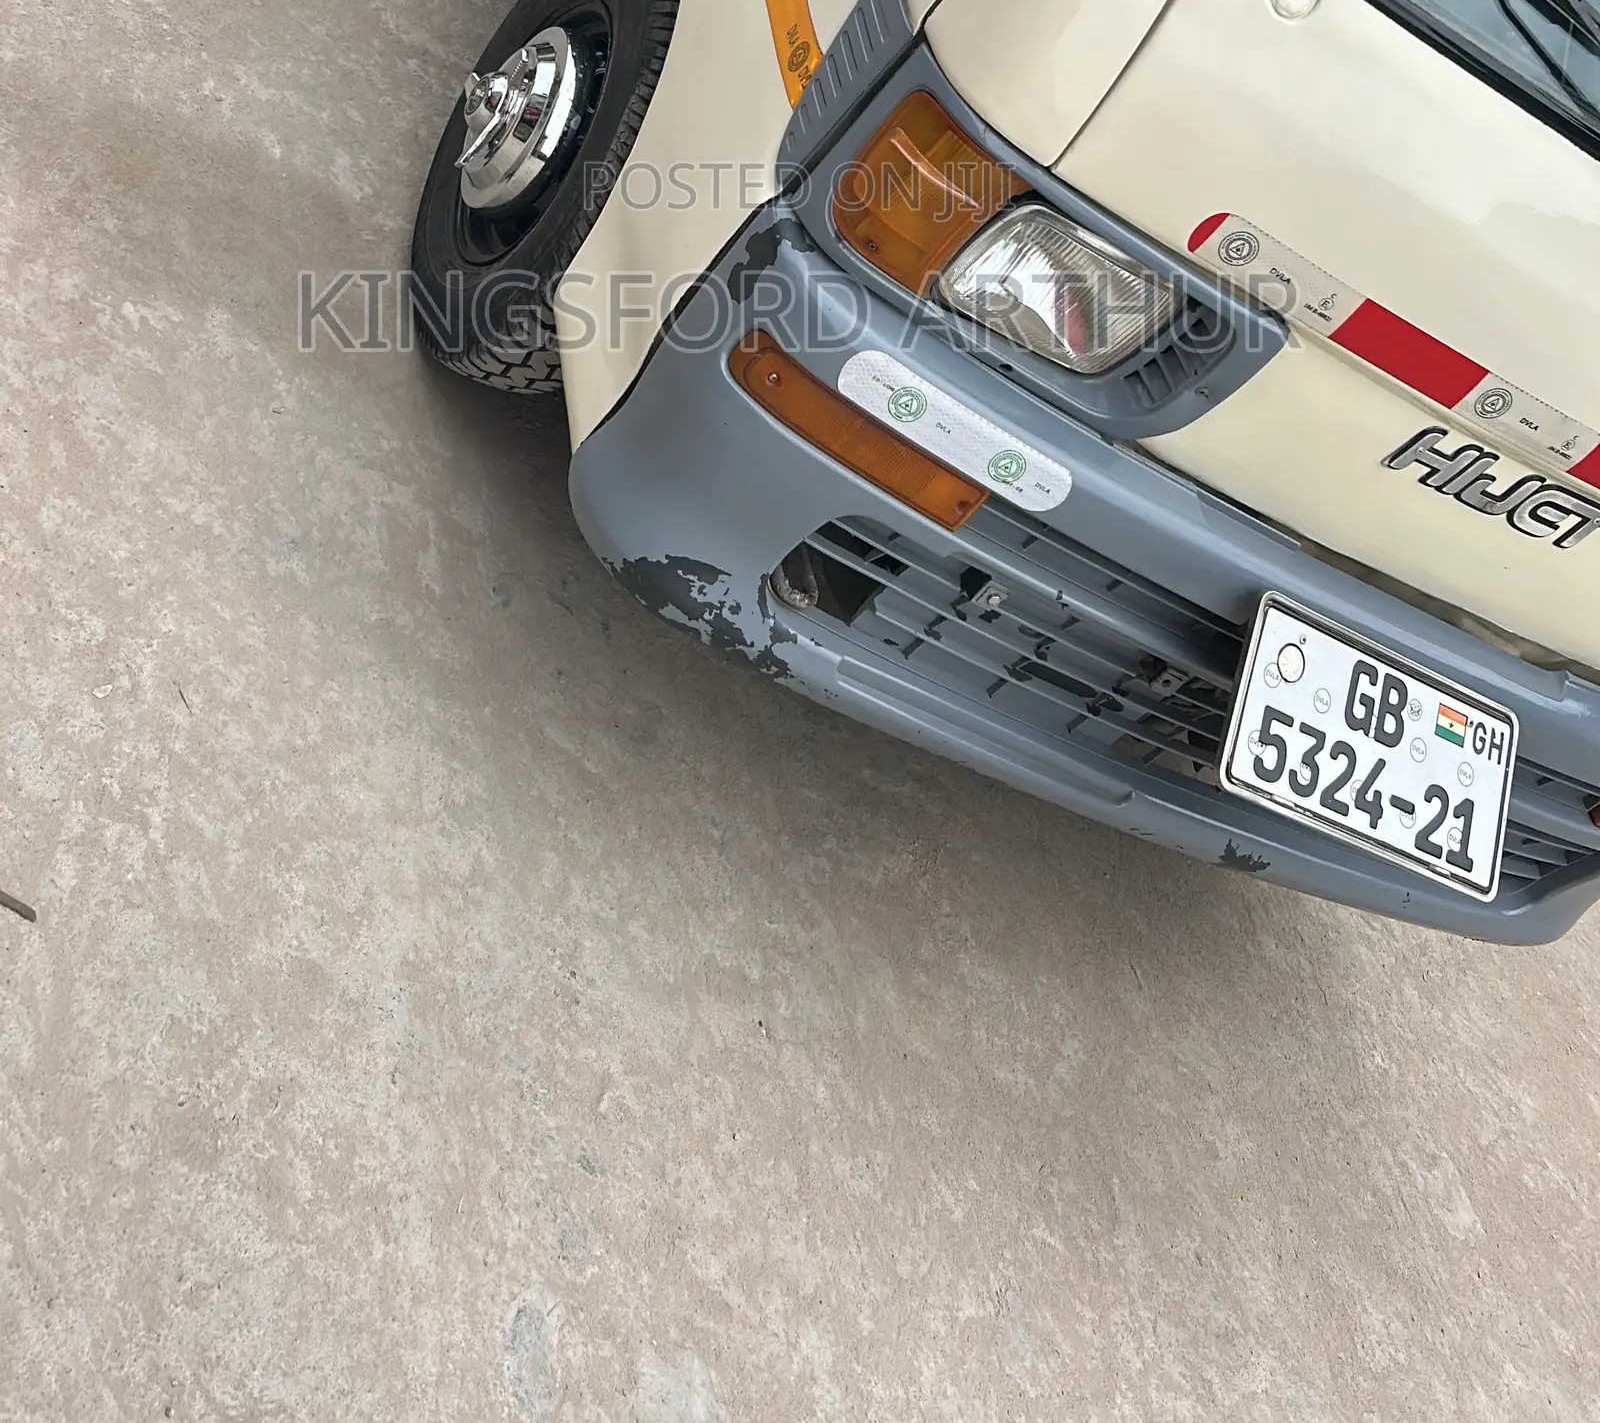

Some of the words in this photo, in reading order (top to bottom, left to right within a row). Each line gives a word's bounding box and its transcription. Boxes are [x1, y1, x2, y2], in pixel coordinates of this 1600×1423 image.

[1269, 267, 1293, 285] DVLA
[1519, 417, 1539, 432] DVLA
[1034, 482, 1051, 495] DVLA
[1344, 659, 1408, 748] GB
[1472, 721, 1505, 766] GH
[1253, 704, 1475, 873] 5324-21
